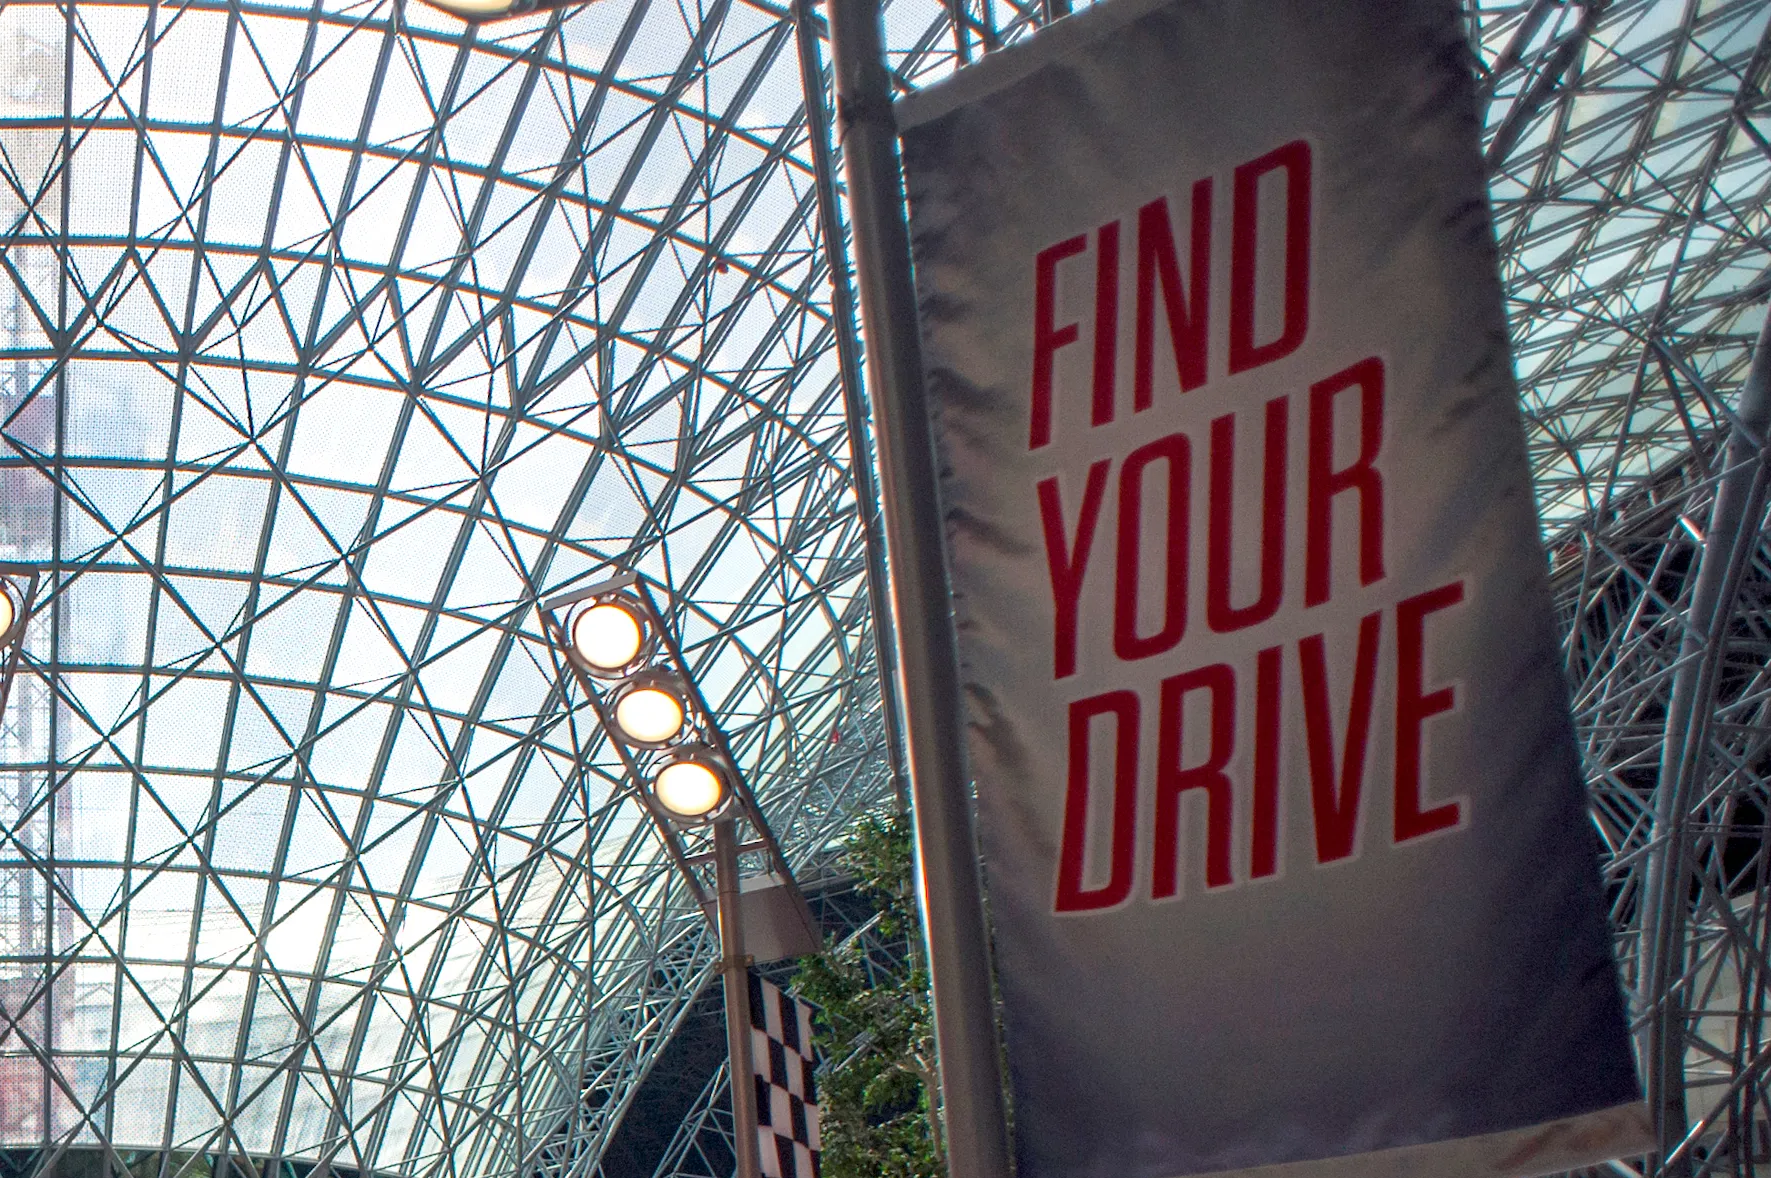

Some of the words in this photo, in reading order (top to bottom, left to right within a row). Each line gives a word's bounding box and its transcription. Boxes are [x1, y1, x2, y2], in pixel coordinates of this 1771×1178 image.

[1029, 139, 1313, 452] FIND
[1037, 355, 1387, 681] YOUR
[1053, 580, 1466, 914] DRIVE
